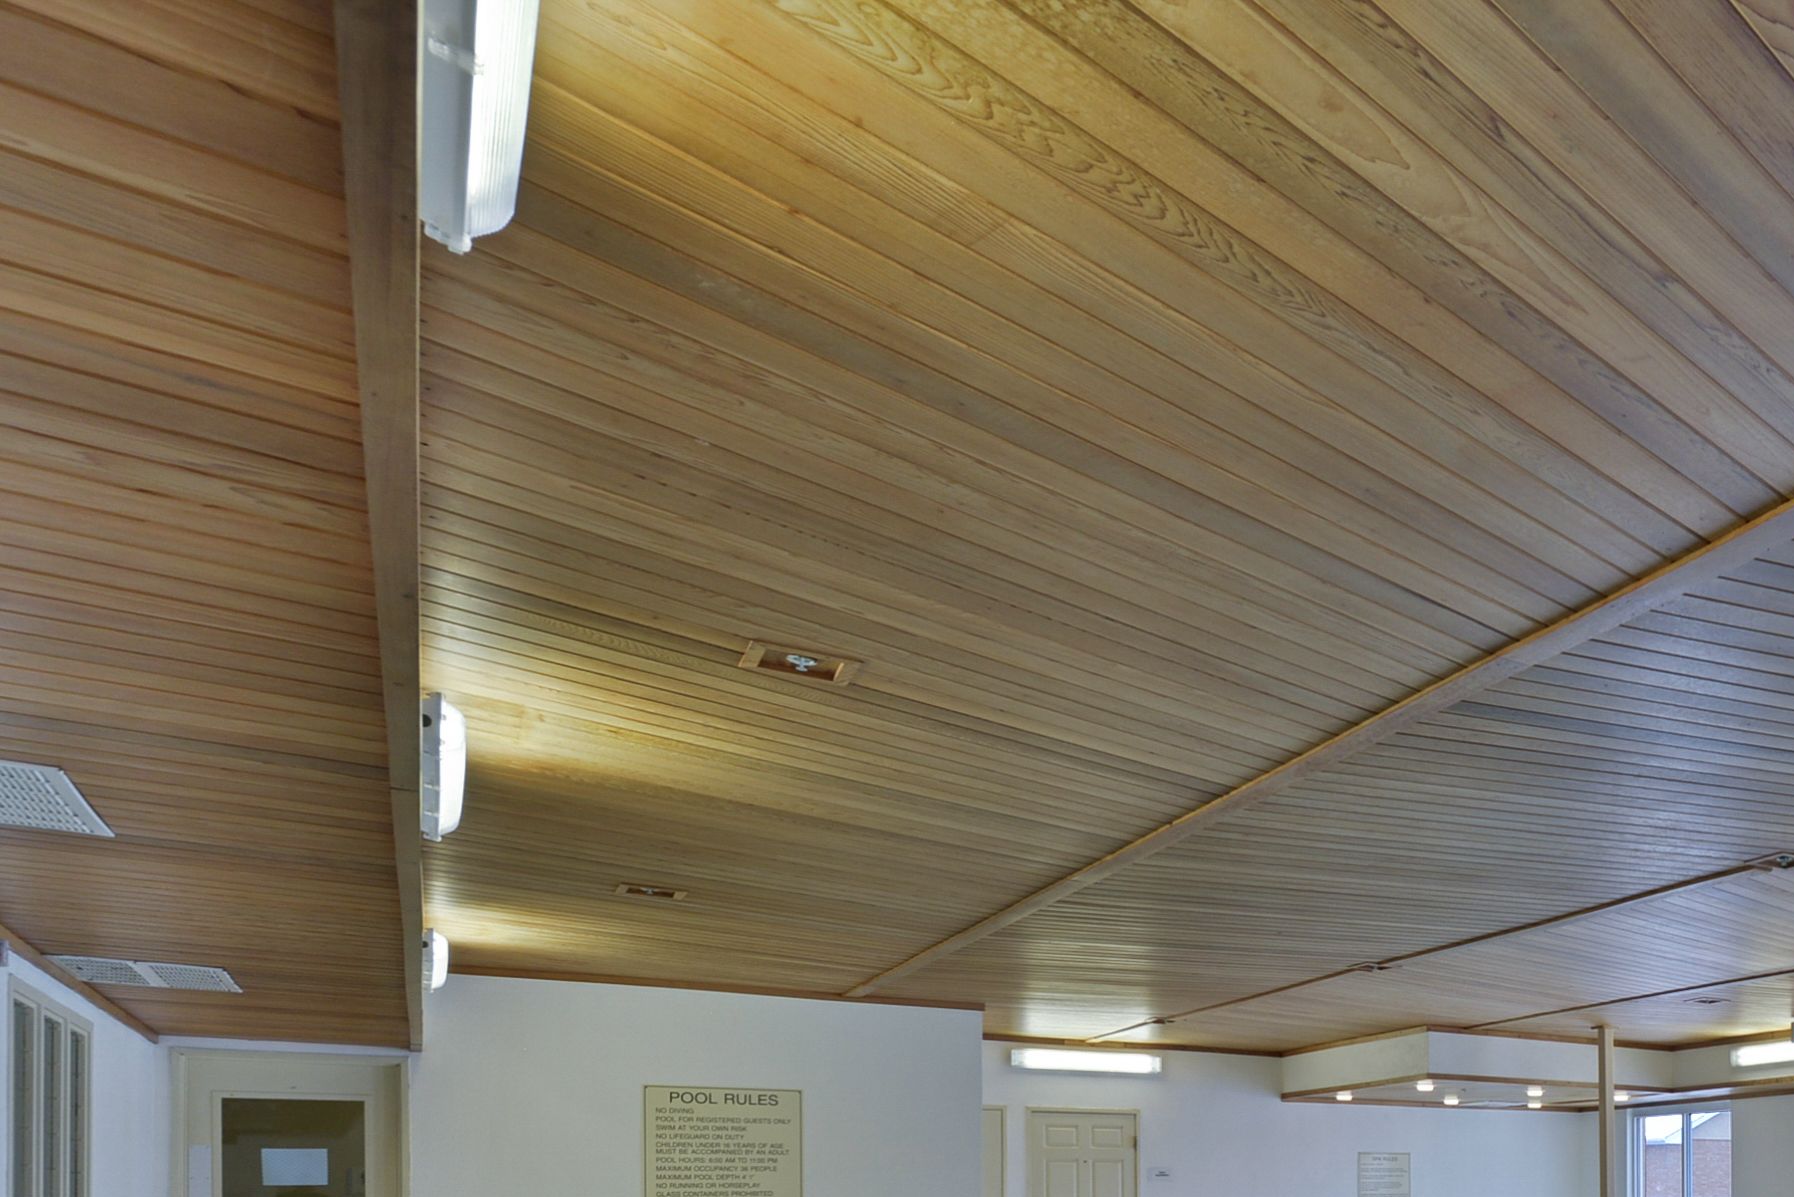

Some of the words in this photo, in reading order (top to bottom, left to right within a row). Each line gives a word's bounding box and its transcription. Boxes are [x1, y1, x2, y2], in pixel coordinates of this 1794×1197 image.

[669, 1091, 718, 1105] POOL
[724, 1093, 779, 1106] RULES
[695, 1116, 742, 1124] REGISTERED
